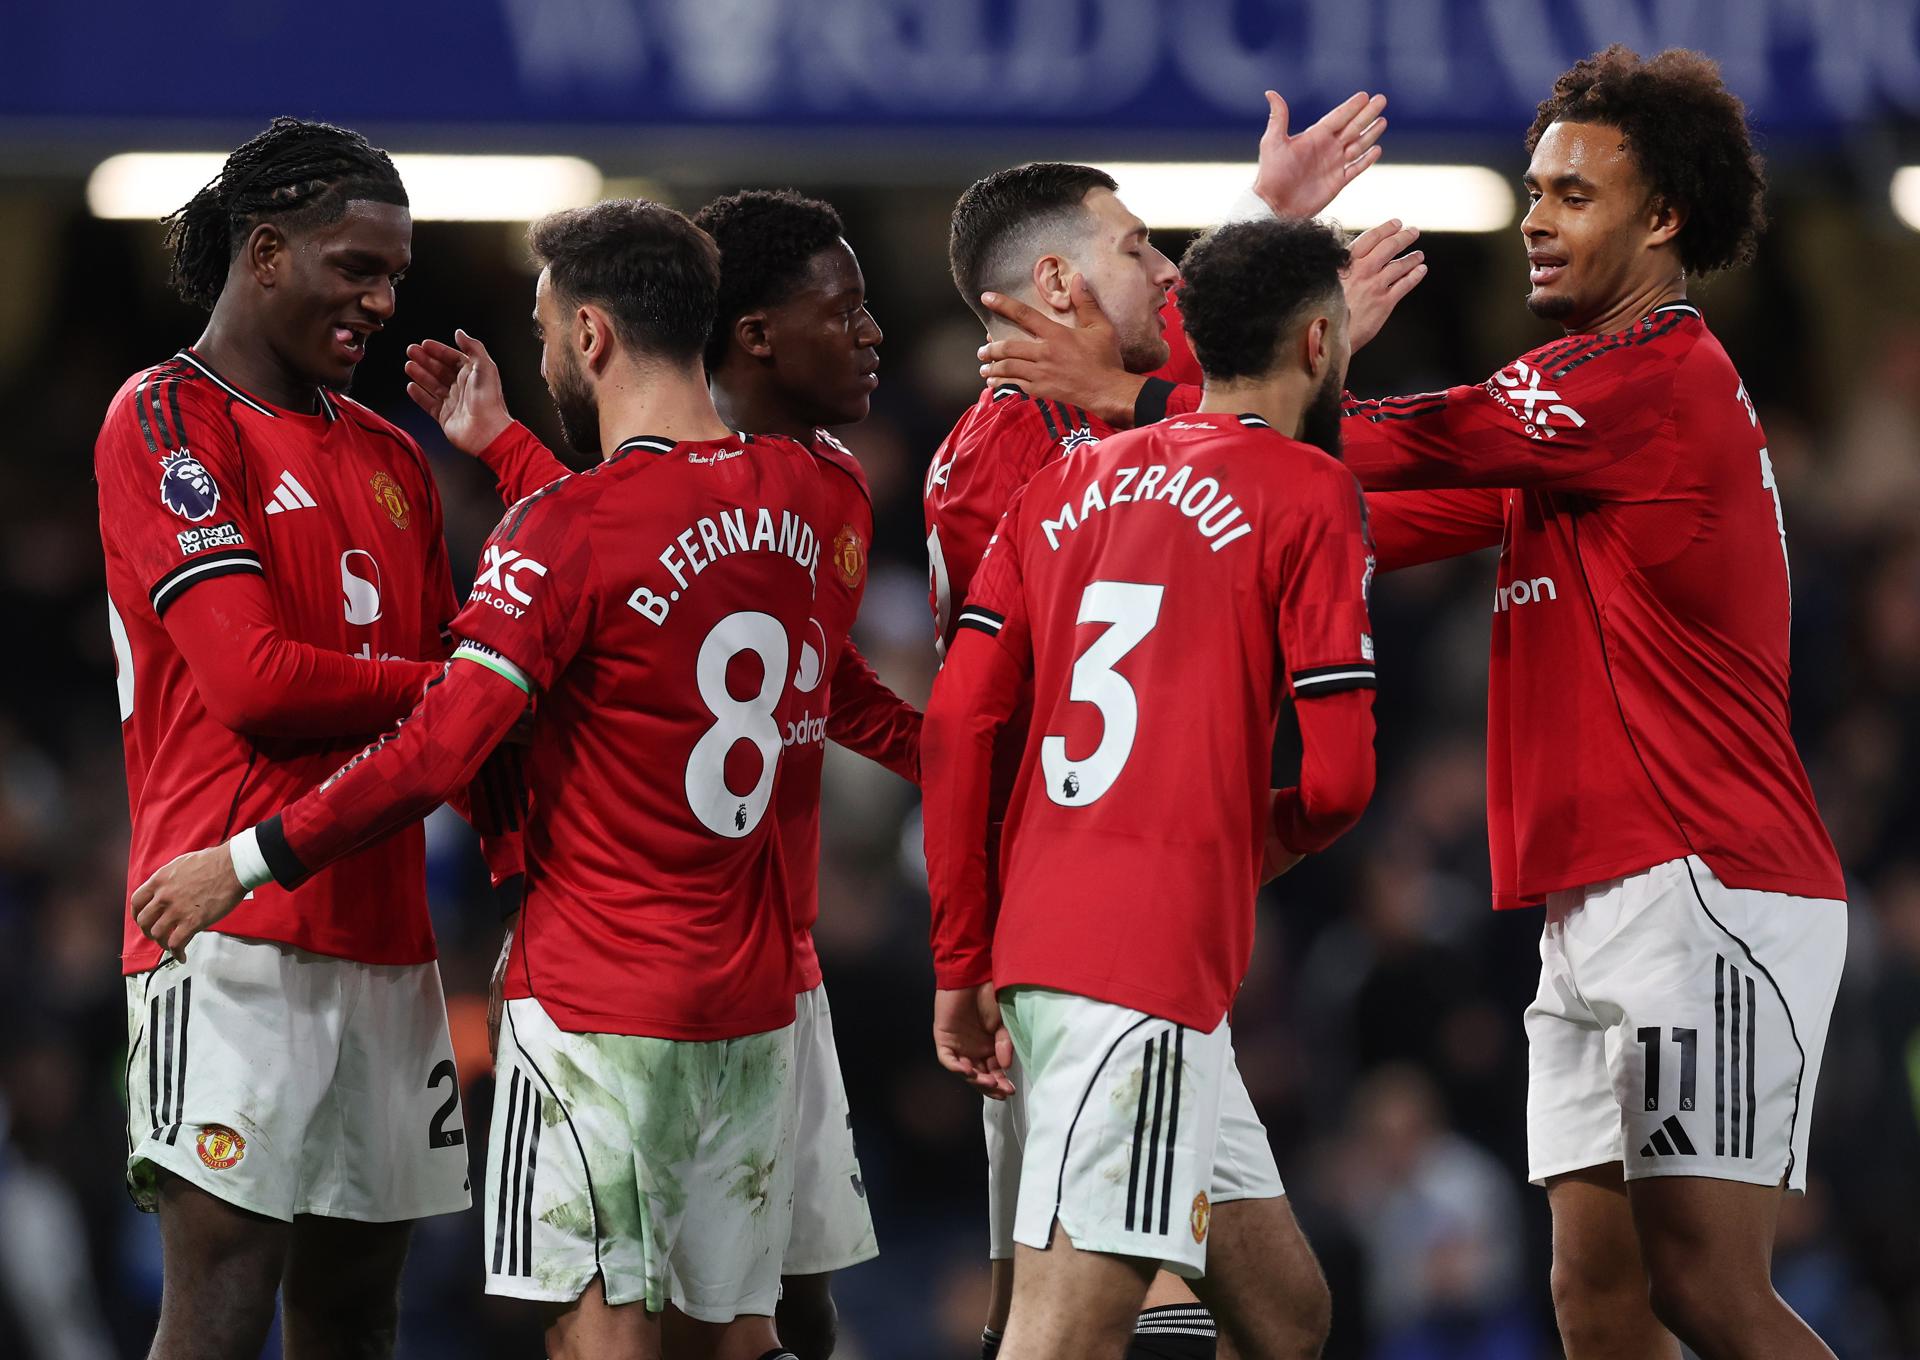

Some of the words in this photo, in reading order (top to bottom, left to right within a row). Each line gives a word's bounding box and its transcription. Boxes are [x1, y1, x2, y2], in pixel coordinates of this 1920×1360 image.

[177, 530, 199, 545] No
[200, 524, 235, 538] room
[181, 541, 201, 556] for
[203, 533, 244, 549] racism
[1041, 465, 1252, 553] MAZRAOUI
[473, 545, 548, 606] XC
[627, 508, 820, 626] B.FERNANDE
[685, 611, 789, 839] 8
[1041, 580, 1165, 807] 3
[427, 1059, 464, 1149] 2
[1637, 1026, 1698, 1112] 11
[201, 1152, 228, 1168] UNITED
